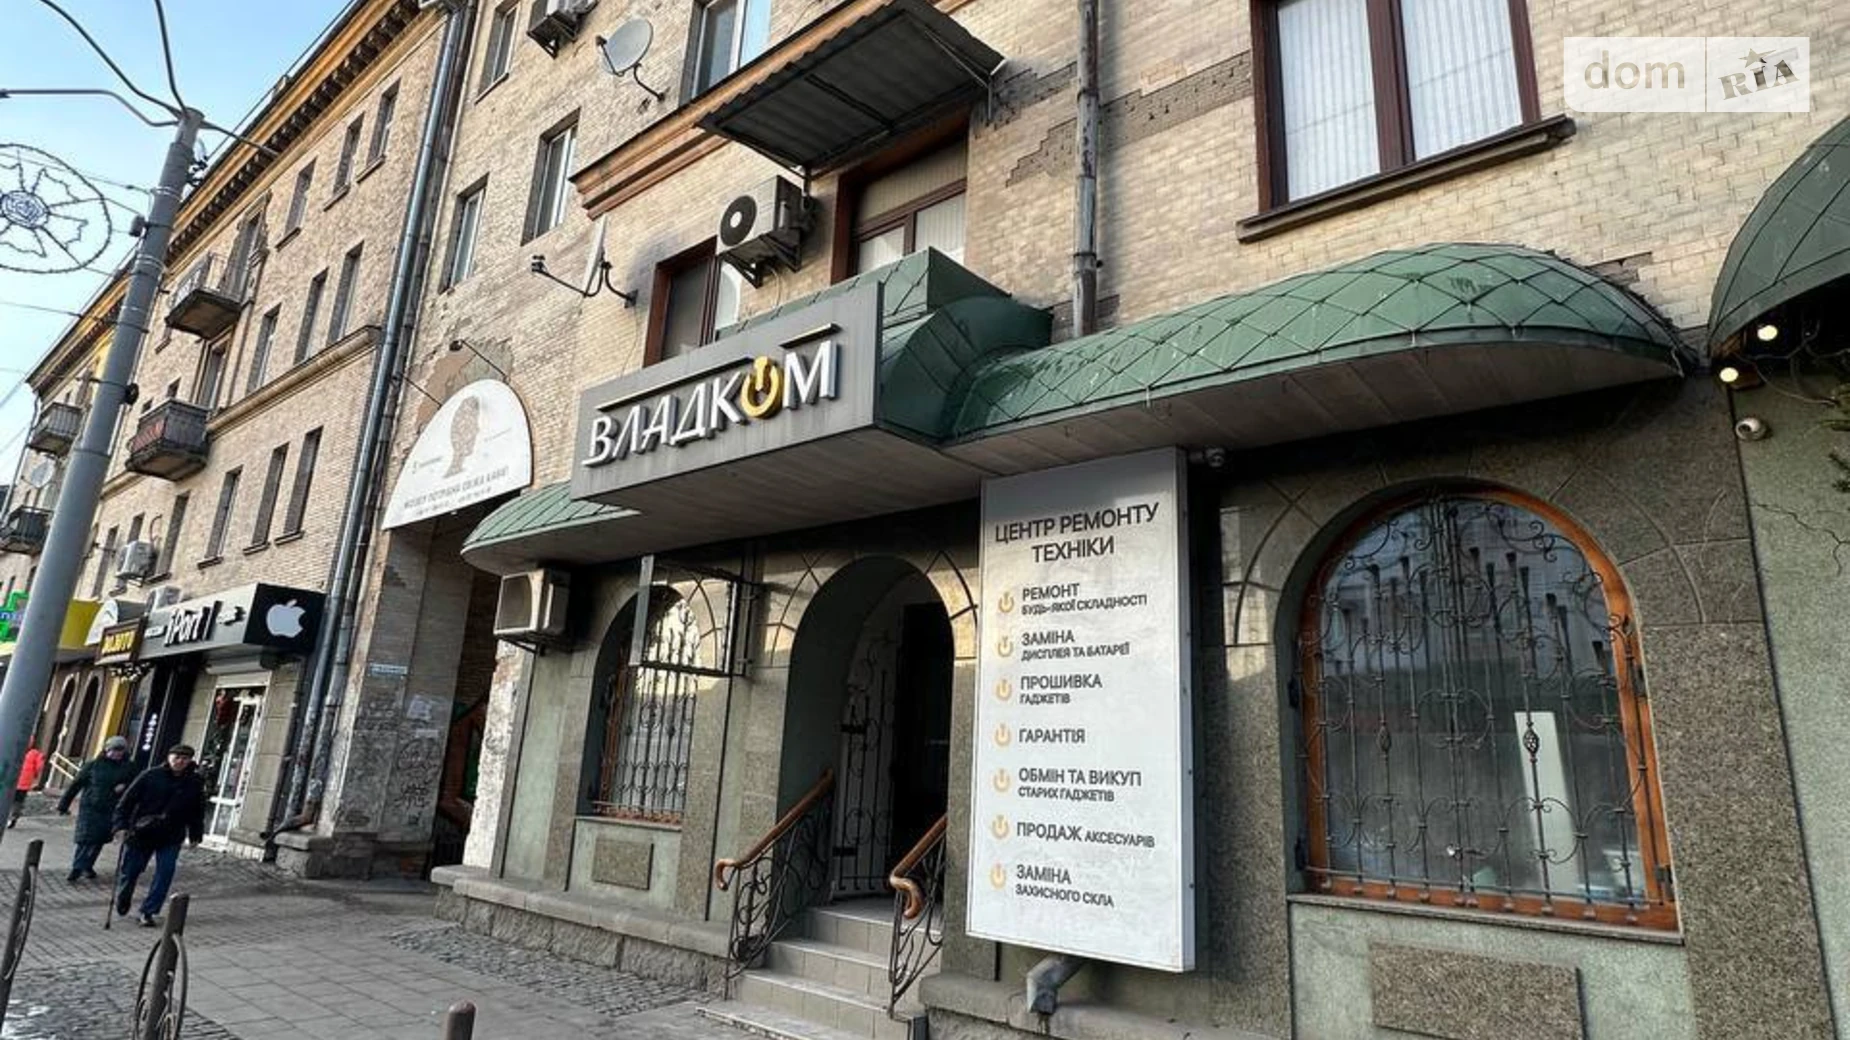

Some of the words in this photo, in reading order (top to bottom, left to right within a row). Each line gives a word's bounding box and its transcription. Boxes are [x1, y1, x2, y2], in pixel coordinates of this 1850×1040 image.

[582, 340, 836, 467] ВЛАДКОМ
[995, 518, 1055, 544] ЦЕНТР
[1060, 502, 1159, 534] РЕМОНТУ
[1032, 536, 1115, 563] ТЕХНІКИ
[1022, 583, 1080, 601] РЕМОНТ
[1022, 599, 1076, 616] БУДЬ-ЯКОЇ
[1077, 594, 1148, 611] СКЛАДНОСТІ
[1021, 629, 1075, 646] ЗАМІНА
[1021, 646, 1071, 662] ДИСПЛЕЯ
[1072, 646, 1086, 658] ТА
[1086, 641, 1130, 657] БАТАРЕЇ
[1020, 673, 1103, 690] ПРОШИВКА
[1019, 693, 1071, 706] ГАДЖЕТІВ
[1018, 728, 1085, 743] ГАРАНТІЯ
[1018, 767, 1065, 784] ОБМІН
[1067, 769, 1086, 784] ТА
[1088, 770, 1142, 786] ВИКУП
[1018, 785, 1059, 799] СТАРИХ
[1060, 788, 1115, 802] ГАДЖЕТІВ
[1016, 822, 1082, 841] ПРОДАЖ
[1084, 831, 1155, 848] АКСЕСУАРІВ
[1016, 864, 1072, 884] ЗАМІНА
[1015, 883, 1081, 903] ЗАХИСНОГО
[1082, 892, 1115, 908] СКЛА
